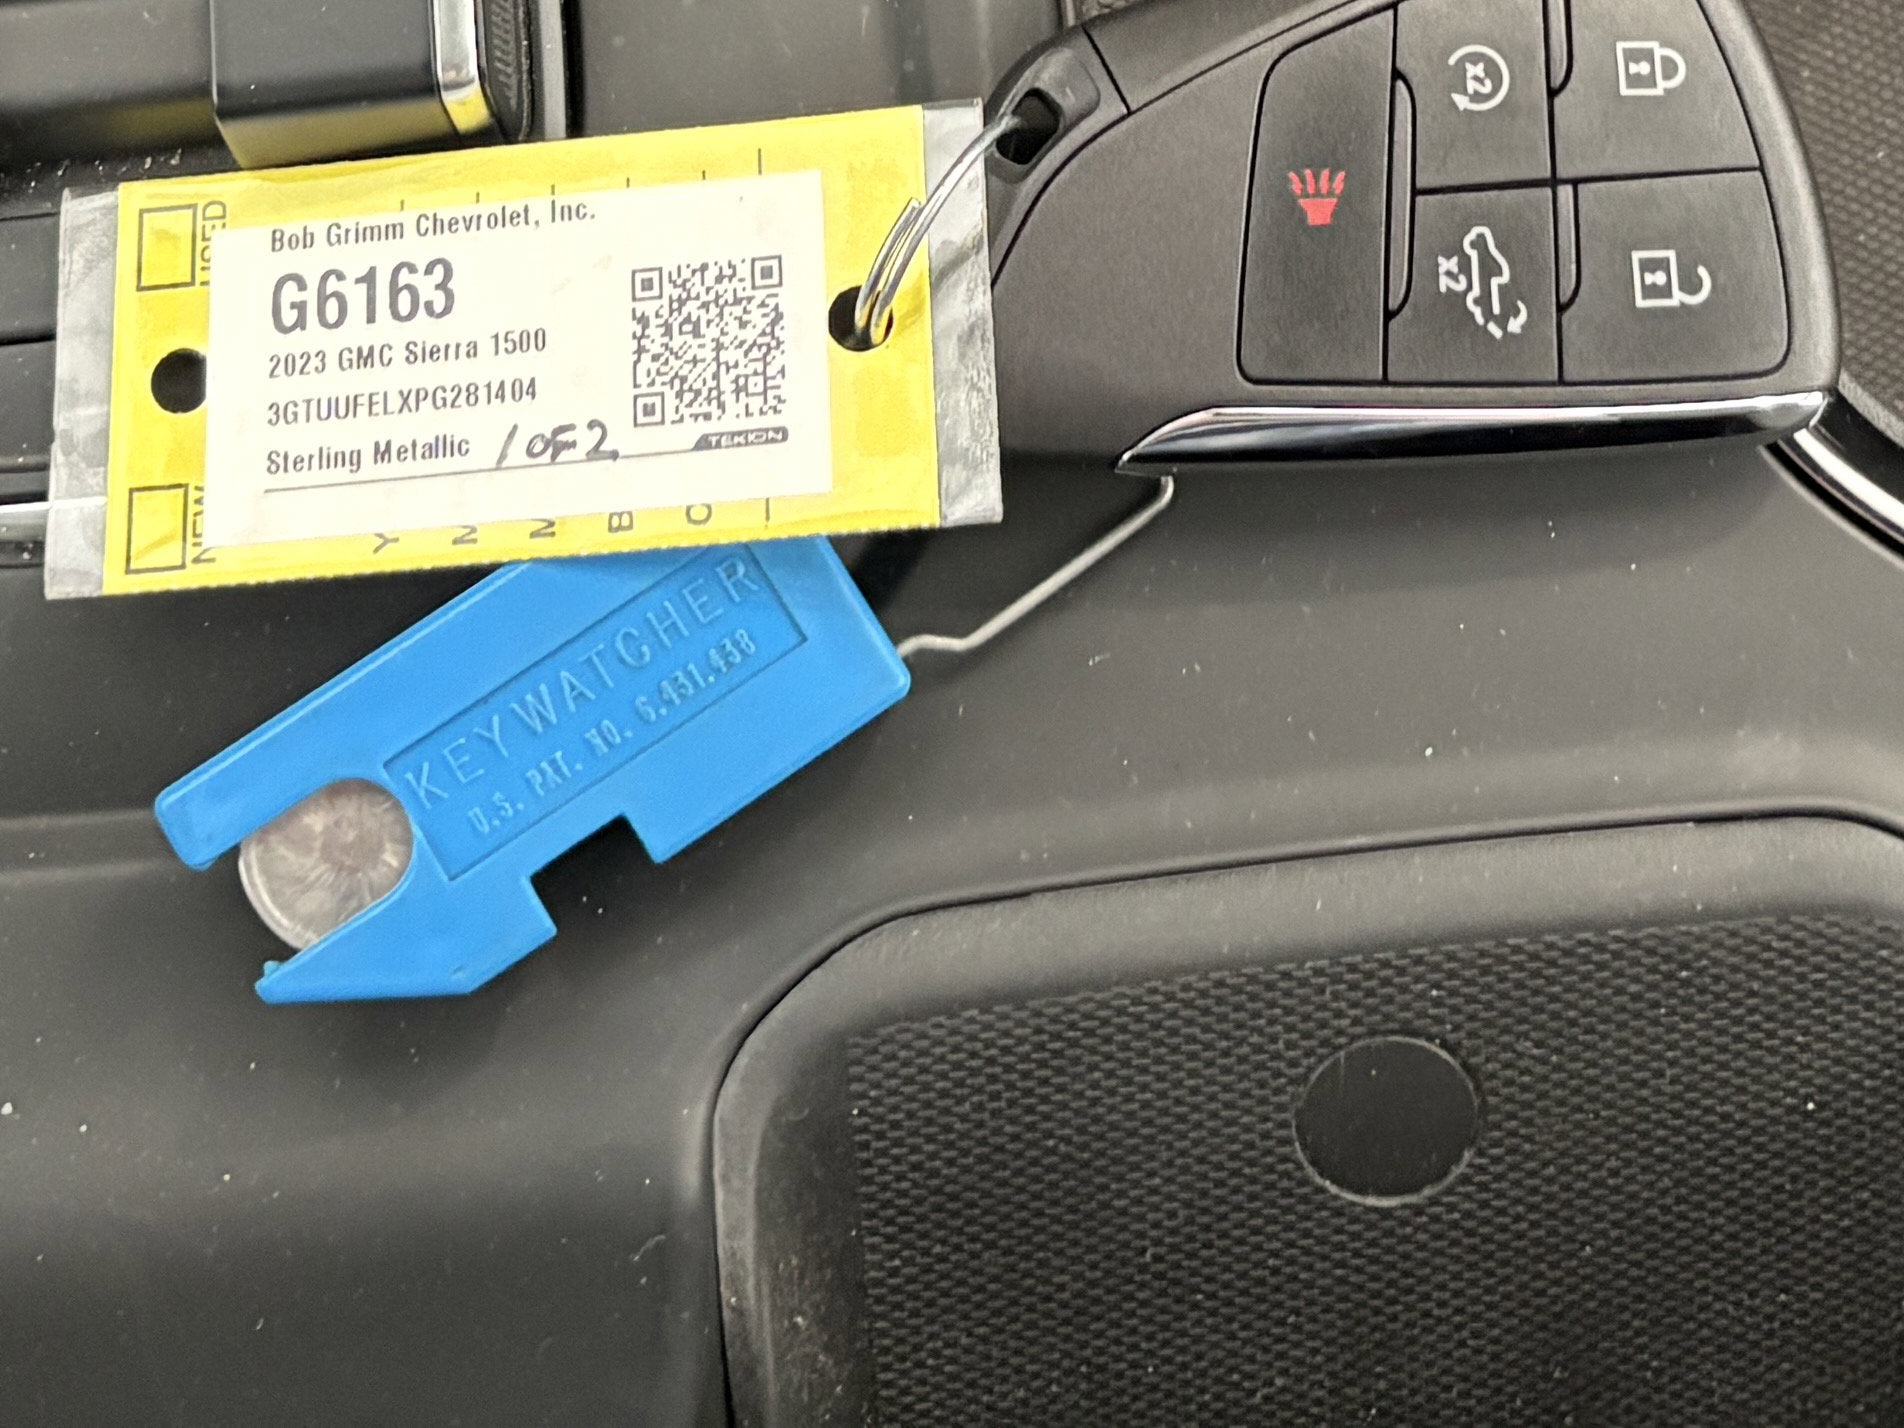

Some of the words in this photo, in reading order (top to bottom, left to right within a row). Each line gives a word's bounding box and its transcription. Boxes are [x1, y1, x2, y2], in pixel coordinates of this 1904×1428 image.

[270, 225, 315, 253] Bob
[326, 219, 405, 247] Grimm
[416, 204, 540, 237] Chevrolet,
[550, 199, 596, 223] Inc.
[271, 257, 455, 334] G6163
[268, 349, 327, 379] 2023
[338, 343, 393, 371] GMC
[404, 338, 479, 365] Sierra
[491, 327, 547, 356] 1500
[267, 376, 537, 426] 3GTUUFELXPG281404
[266, 446, 363, 475] Sterling
[373, 434, 471, 464] Metallic
[586, 419, 619, 461] 2
[467, 791, 525, 834] U.S.
[525, 750, 584, 796] PAT.
[584, 719, 634, 754] NO.
